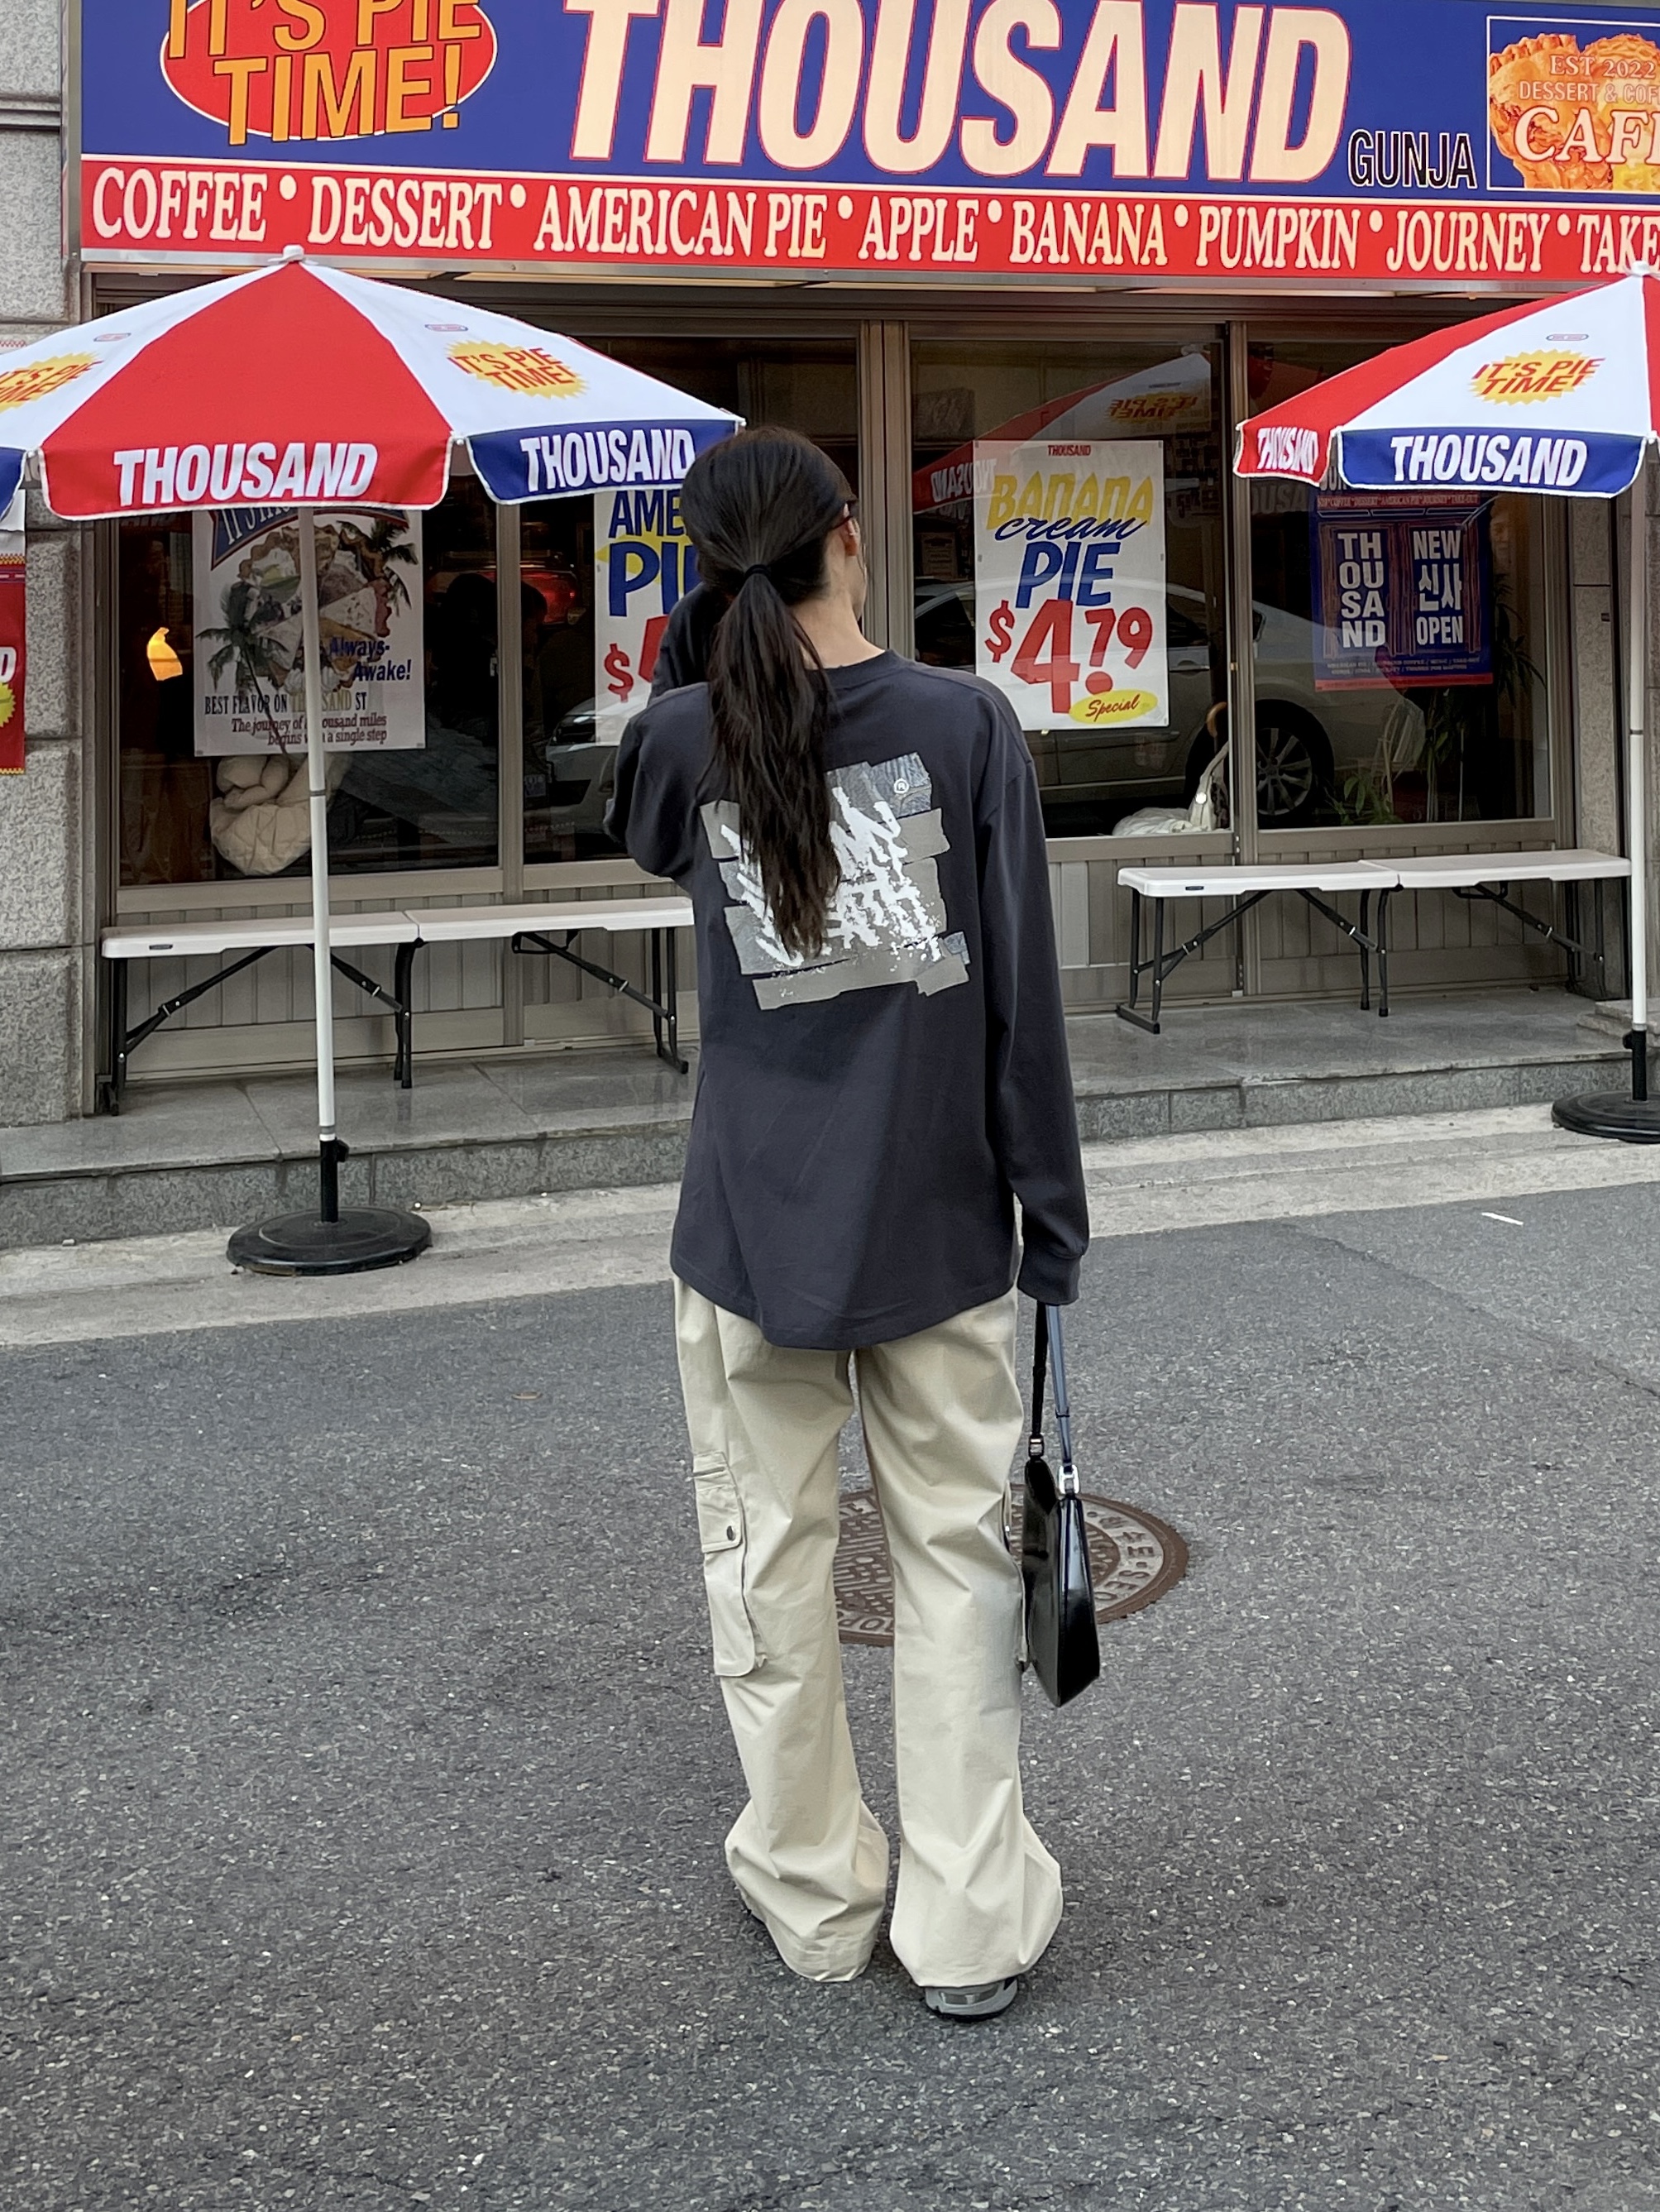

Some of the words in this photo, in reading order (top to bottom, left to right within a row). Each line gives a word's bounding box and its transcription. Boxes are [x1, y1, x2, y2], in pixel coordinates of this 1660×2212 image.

[1550, 55, 1595, 76] EST
[1603, 59, 1655, 79] 2022
[213, 44, 460, 146] TIME!
[562, 0, 1352, 182] THOUSAND
[1519, 81, 1598, 102] DESSERT
[1605, 83, 1618, 103] &
[1623, 84, 1660, 104] COF
[1347, 129, 1478, 189] GUNJA
[93, 166, 268, 242] COFFEE
[308, 176, 503, 251] DESSERT
[533, 184, 756, 258] AMERICAN
[765, 192, 827, 260] PIE
[858, 196, 979, 264] APPLE
[1009, 199, 1168, 266] BANANA
[1195, 205, 1360, 271] PUMPKIN
[1386, 209, 1550, 275] JOURNEY
[447, 353, 510, 374] IT'S
[503, 347, 562, 367] PIE
[1471, 361, 1542, 380] IT'S
[1547, 357, 1606, 375] PIE
[485, 365, 577, 390] TIME!
[1481, 374, 1587, 395] TIME!
[519, 429, 696, 493] THOUSAND
[1047, 444, 1091, 457] THOUSAND
[1390, 434, 1587, 486] THOUSAND
[113, 442, 378, 507] THOUSAND
[994, 515, 1147, 542] cream
[1337, 532, 1382, 560] TH
[1413, 530, 1461, 560] NEW
[1015, 541, 1121, 609] PIE
[1339, 561, 1384, 590] OU
[1418, 563, 1462, 611] 신사
[1341, 591, 1385, 619] SA
[1342, 620, 1386, 649] ND
[1416, 615, 1464, 646] OPEN
[352, 660, 412, 681] Awake!
[204, 695, 229, 716] BEST
[232, 694, 270, 715] FLAVOR
[274, 694, 288, 713] ON
[355, 692, 367, 711] ST
[1085, 693, 1141, 722] Special
[232, 718, 251, 733] The
[360, 711, 387, 726] miles
[336, 730, 365, 746] single
[367, 729, 388, 745] step
